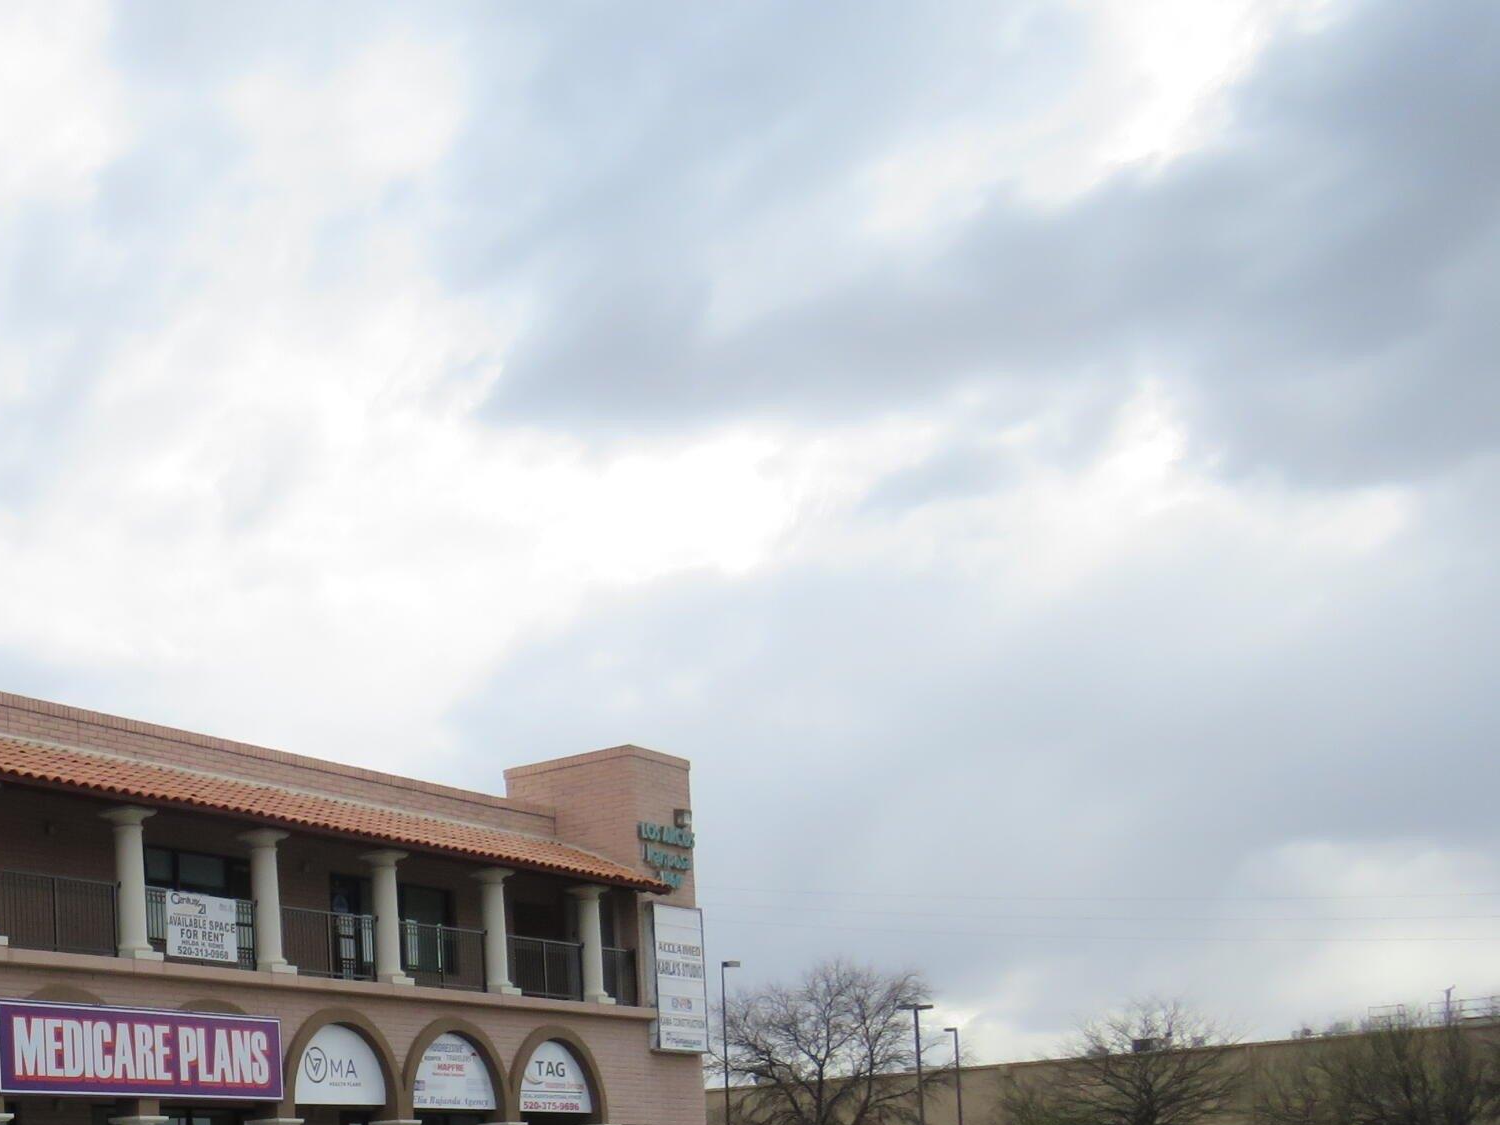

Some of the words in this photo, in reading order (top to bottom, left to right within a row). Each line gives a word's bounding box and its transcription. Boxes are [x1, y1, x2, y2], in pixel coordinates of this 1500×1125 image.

[637, 822, 660, 842] LOS
[198, 904, 207, 915] 21
[169, 915, 207, 930] AVAILABLE
[209, 920, 236, 934] SPACE
[180, 928, 198, 940] FOR
[202, 930, 225, 944] RENT
[12, 1016, 174, 1082] MEDICARE
[177, 1026, 270, 1086] PLANS
[330, 1058, 358, 1079] MA
[436, 1063, 465, 1072] MAPFRE
[535, 1060, 566, 1078] TAG
